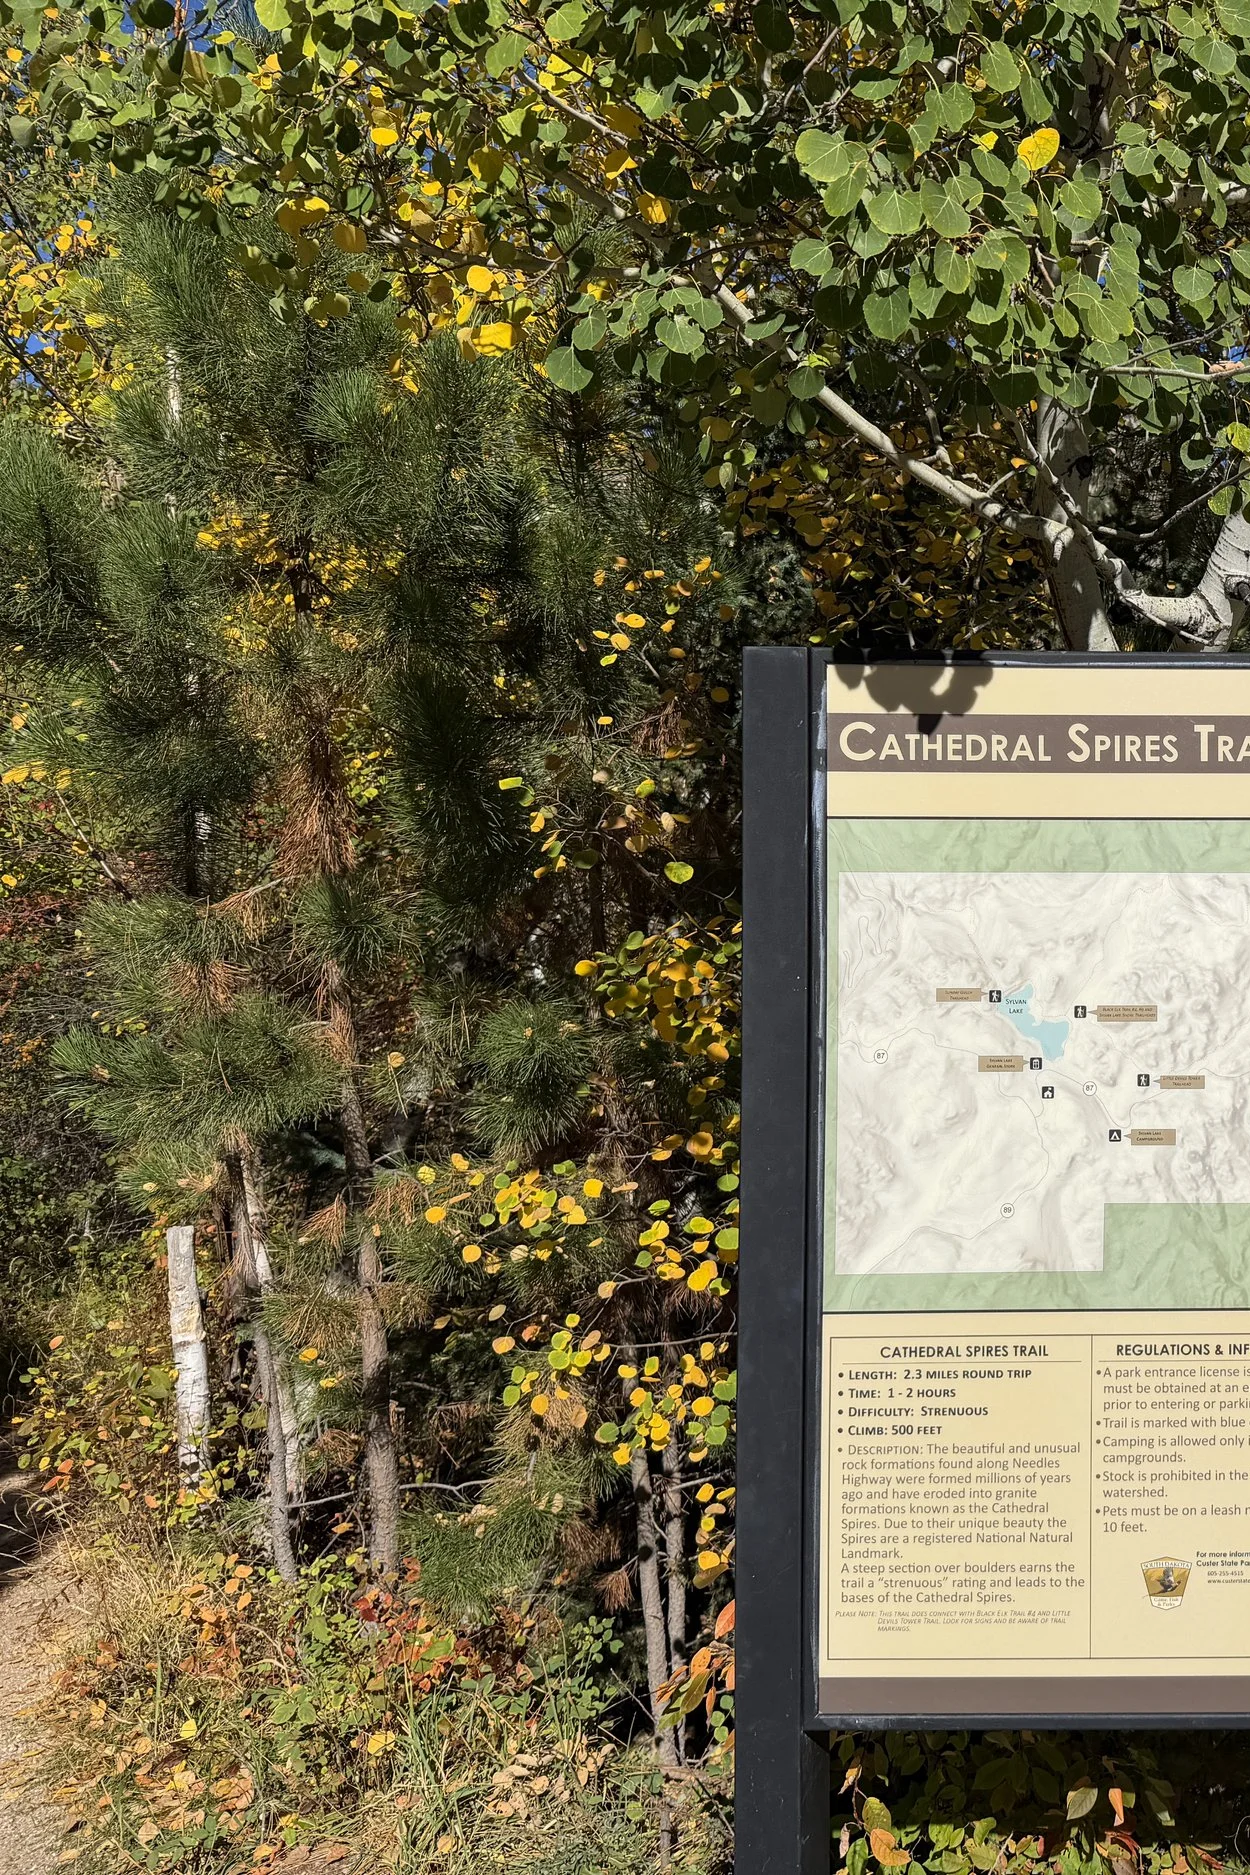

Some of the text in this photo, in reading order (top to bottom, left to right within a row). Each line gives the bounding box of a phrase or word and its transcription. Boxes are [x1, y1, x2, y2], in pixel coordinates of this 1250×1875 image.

[839, 721, 1051, 761] CATHEDRAL
[1067, 723, 1178, 762] SPIRES
[1085, 1084, 1094, 1092] 87
[1003, 1206, 1012, 1214] 89
[880, 1345, 1049, 1358] CATHEDRAL SPIRES TRAIL
[1116, 1343, 1210, 1356] REGULATIONS
[1215, 1344, 1224, 1355] &
[849, 1369, 1032, 1380] LENGTH: 2.3 MILES ROUND TRIP
[1103, 1367, 1112, 1378] A
[1115, 1366, 1141, 1380] park
[1144, 1368, 1196, 1378] entrance
[1200, 1366, 1240, 1377] license
[848, 1388, 880, 1399] TIME:
[888, 1388, 895, 1398] 1
[906, 1387, 913, 1398] 2
[917, 1389, 956, 1398] HOURS
[1103, 1384, 1133, 1394] must
[1136, 1382, 1151, 1394] be
[1154, 1381, 1206, 1394] obtained
[1210, 1383, 1221, 1393] at
[1224, 1384, 1239, 1393] an
[848, 1406, 988, 1417] DIFFICULTY: STRENUOUS
[1103, 1399, 1132, 1412] prior
[1135, 1400, 1147, 1410] to
[1150, 1398, 1200, 1412] entering
[1203, 1400, 1216, 1409] or
[1103, 1417, 1127, 1428] Trail
[1131, 1417, 1140, 1428] is
[1143, 1416, 1187, 1428] marked
[1190, 1416, 1217, 1428] with
[1220, 1416, 1246, 1428] blue
[848, 1424, 942, 1436] CLIMB: 500 FEET
[848, 1442, 1080, 1455] DESCRIPTION: The beautiful and unusual
[842, 1457, 1060, 1471] rock formations found along Needles
[842, 1471, 1071, 1487] Highway were formed millions of years
[1103, 1470, 1135, 1482] Stock
[1138, 1470, 1147, 1482] is
[1150, 1469, 1211, 1484] prohibited
[1215, 1470, 1226, 1481] in
[1229, 1469, 1249, 1481] the
[841, 1487, 1037, 1502] ago and have eroded into granite
[1102, 1486, 1168, 1498] watershed.
